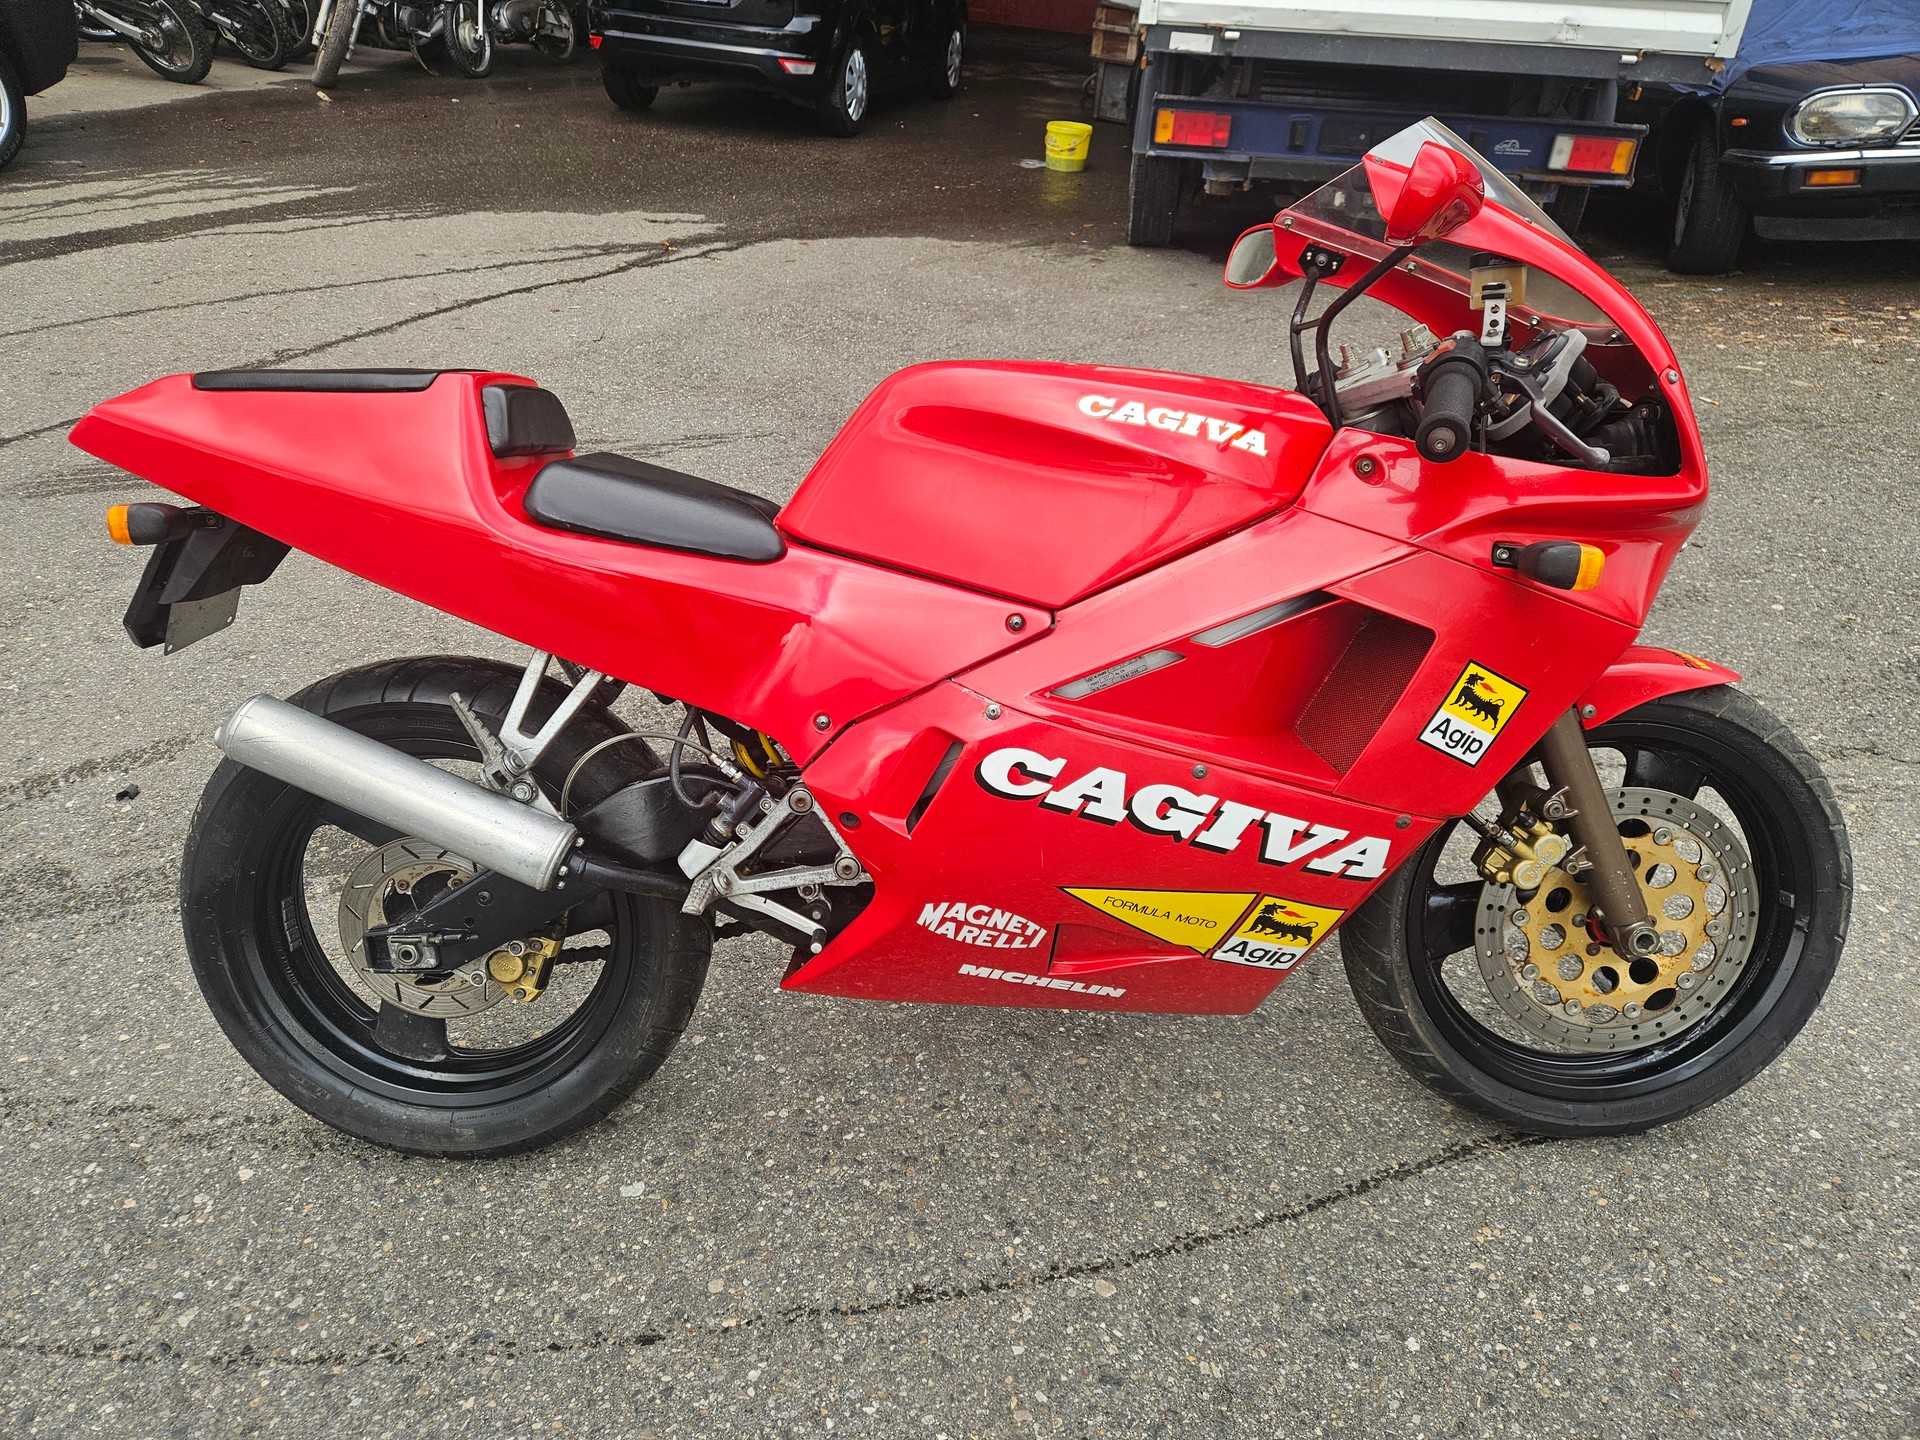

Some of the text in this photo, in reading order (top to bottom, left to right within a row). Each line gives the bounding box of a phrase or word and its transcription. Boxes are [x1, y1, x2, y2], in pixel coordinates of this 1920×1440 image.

[1078, 394, 1268, 456] CAGIVA
[1430, 716, 1484, 756] Agip
[975, 747, 1392, 881] CAGIVA
[916, 902, 1047, 944] MAGNETI
[1103, 896, 1218, 929] FORMULA MOTO
[1221, 939, 1297, 966] Agip
[957, 963, 1127, 998] MICHELIN
